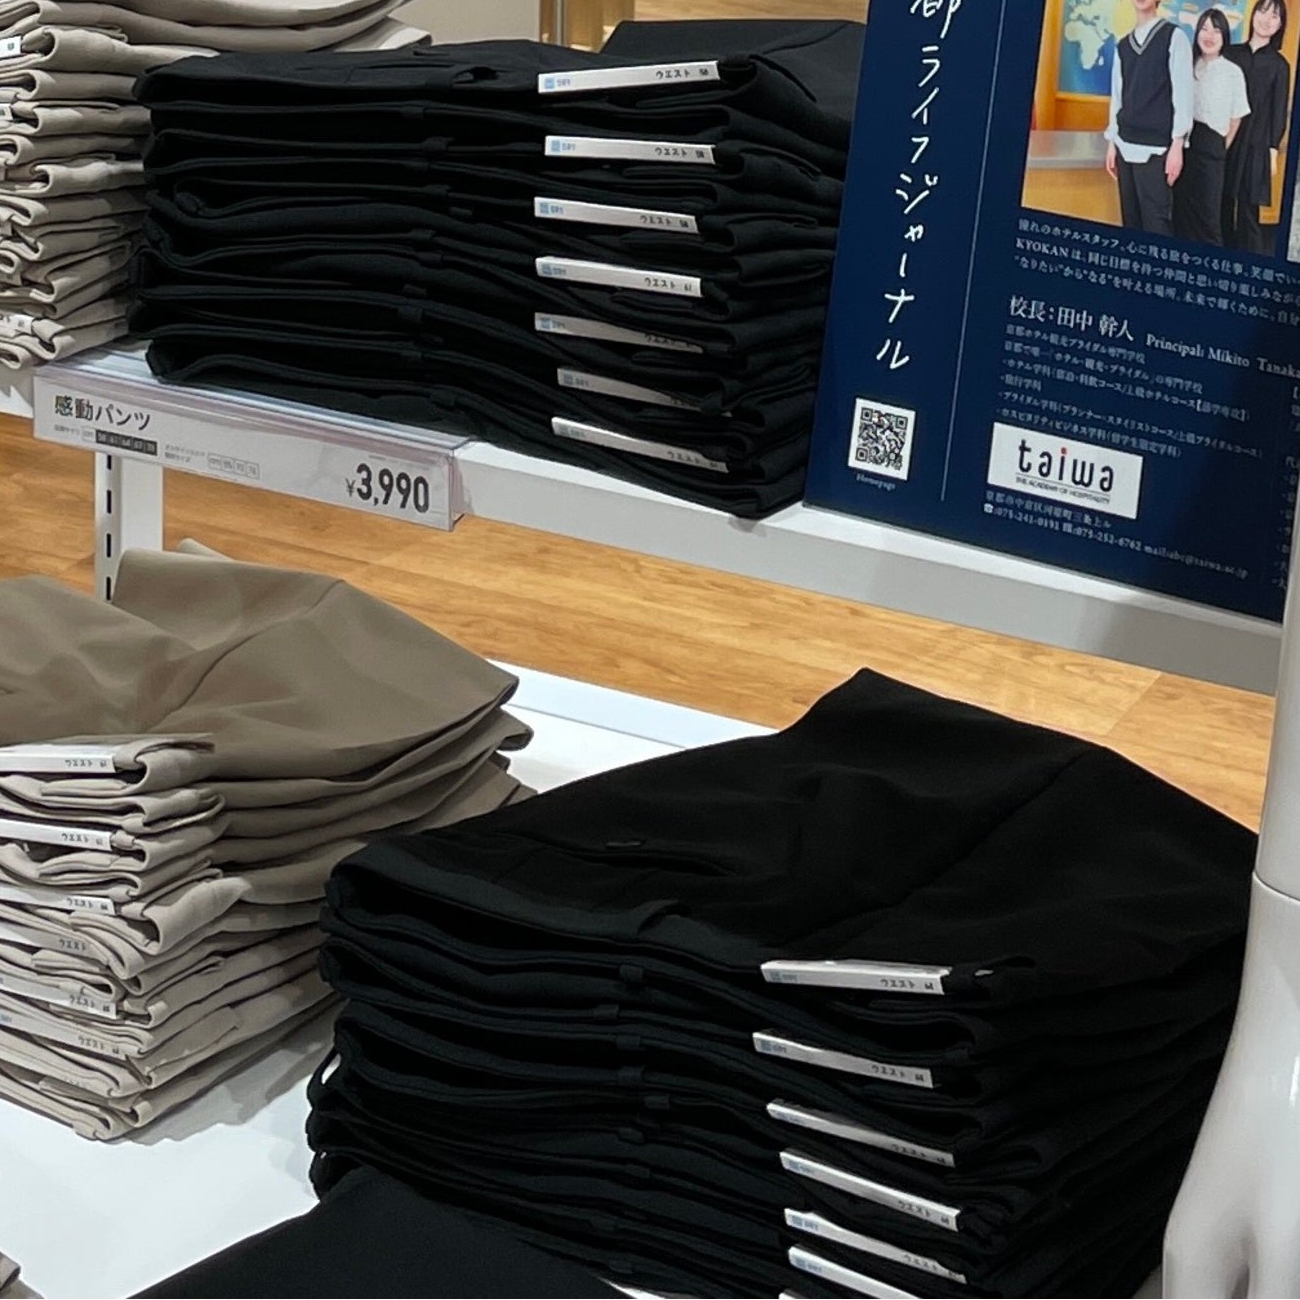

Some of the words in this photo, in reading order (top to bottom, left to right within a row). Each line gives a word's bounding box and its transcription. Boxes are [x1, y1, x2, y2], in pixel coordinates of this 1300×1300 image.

[1098, 315, 1135, 342] 幹人
[1207, 346, 1251, 368] Mikito
[54, 394, 151, 431] 感動パンツ
[1017, 438, 1114, 493] taiwa
